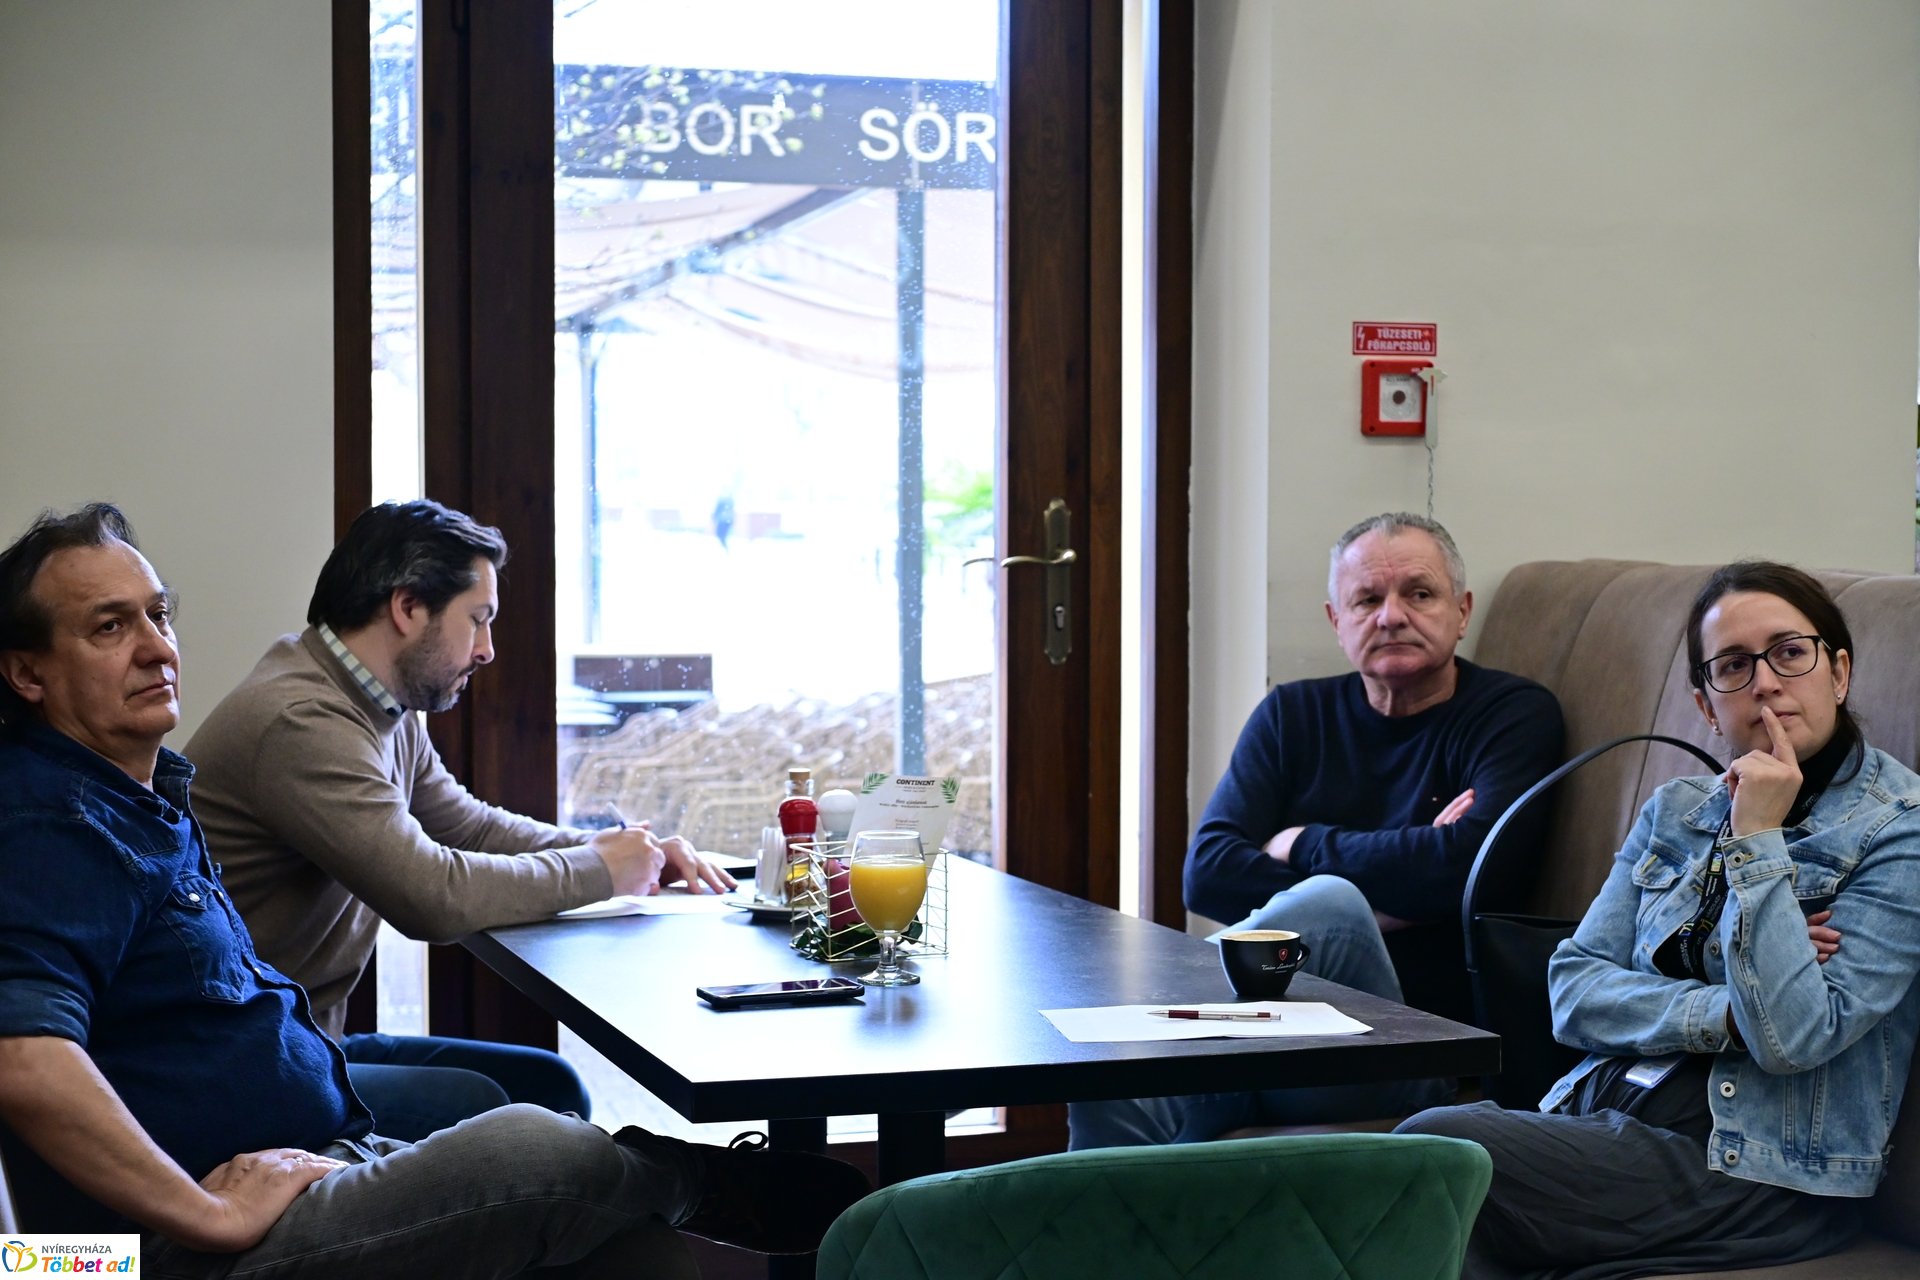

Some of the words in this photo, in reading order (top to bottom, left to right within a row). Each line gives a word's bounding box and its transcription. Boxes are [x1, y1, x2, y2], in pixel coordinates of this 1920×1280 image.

[641, 101, 786, 157] BOR
[858, 102, 996, 164] SÖR
[896, 778, 935, 786] CONTINENT
